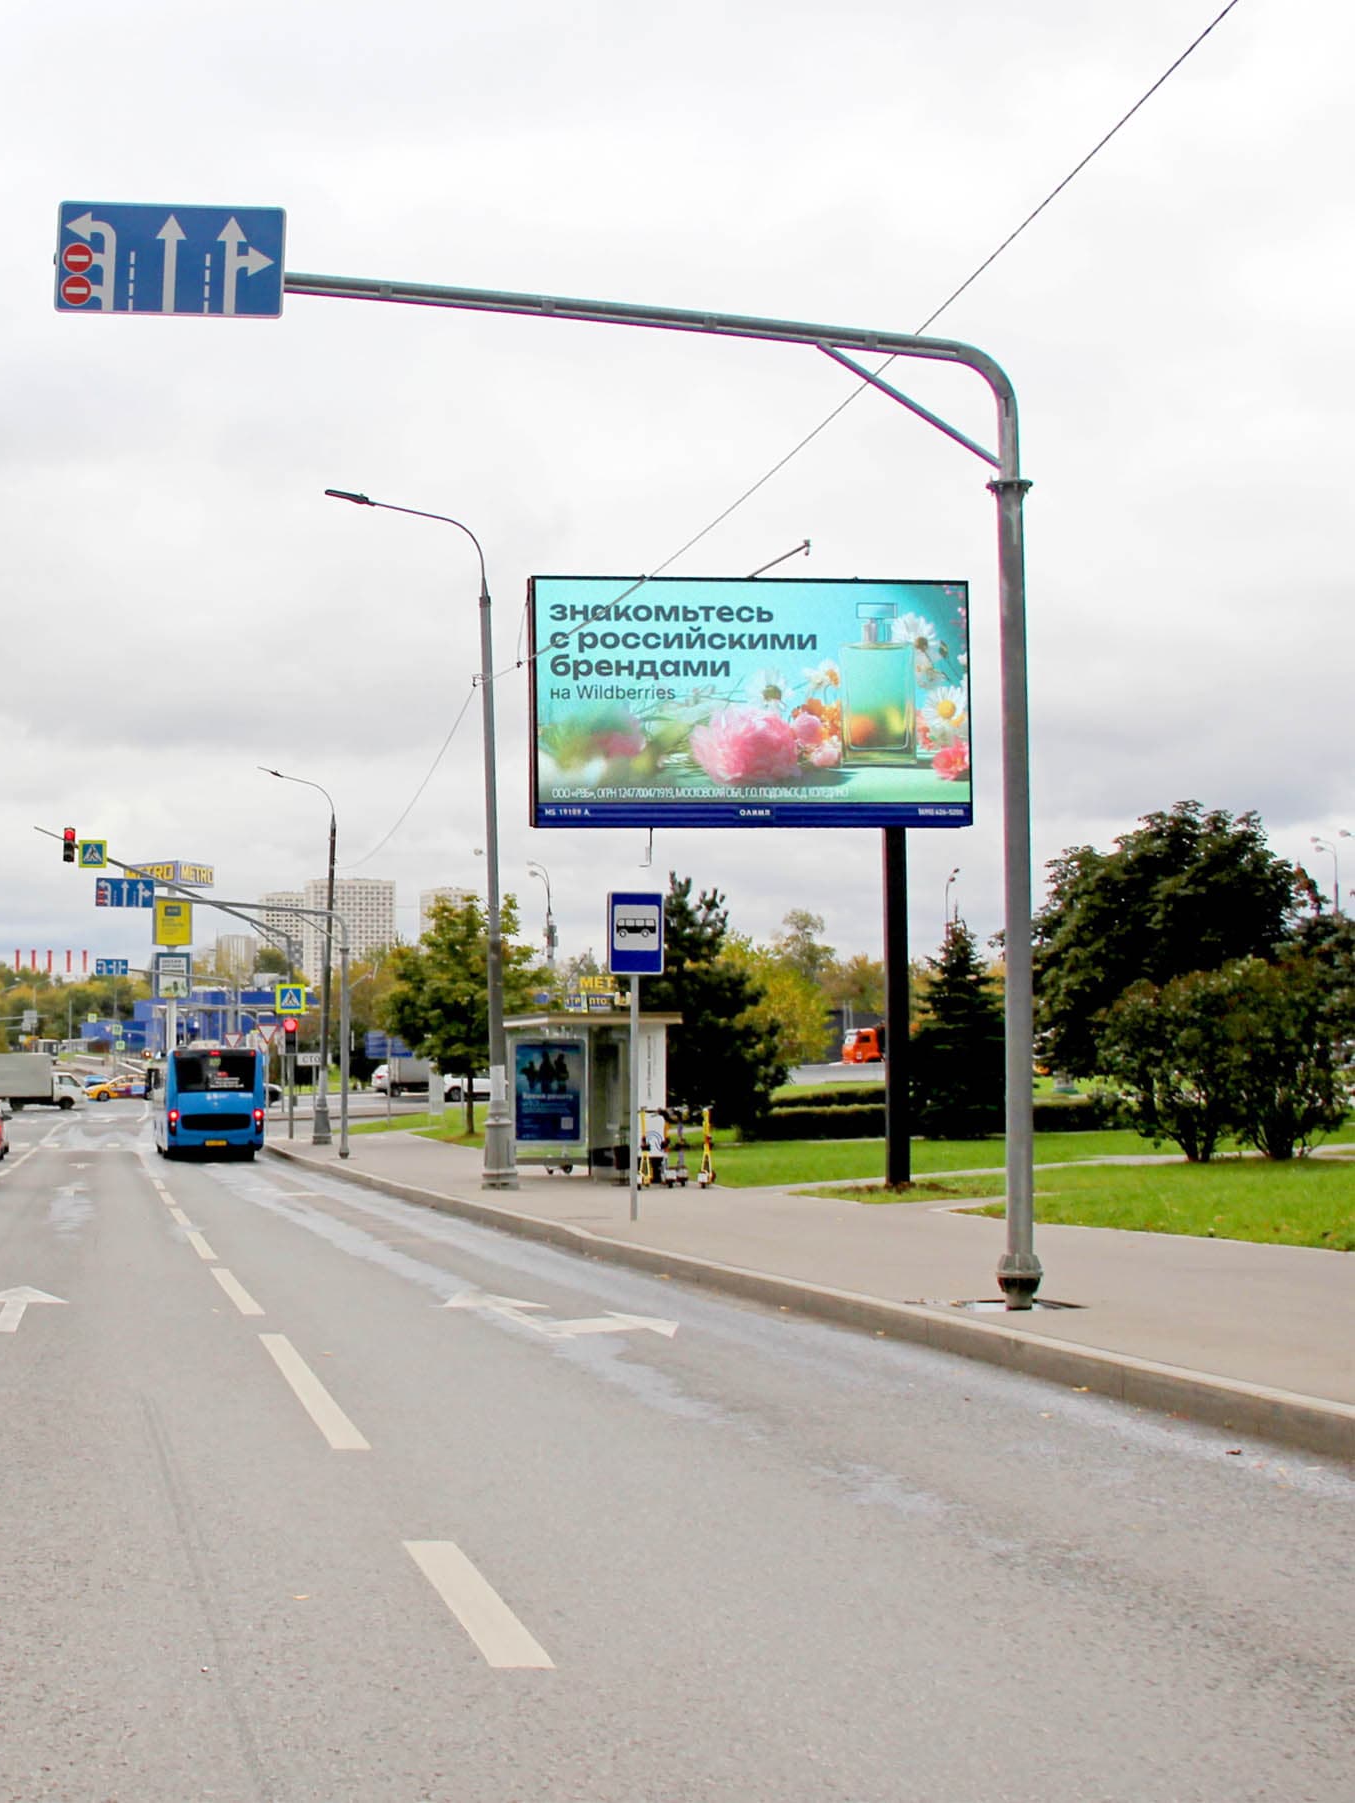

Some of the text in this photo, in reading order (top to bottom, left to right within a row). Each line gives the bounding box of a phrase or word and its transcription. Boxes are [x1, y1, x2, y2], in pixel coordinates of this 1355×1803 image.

[549, 603, 774, 623] знакомьтесь
[549, 625, 818, 653] с российскими
[549, 653, 731, 681] брендами
[549, 684, 677, 700] на Wildberries
[180, 863, 214, 884] METRO
